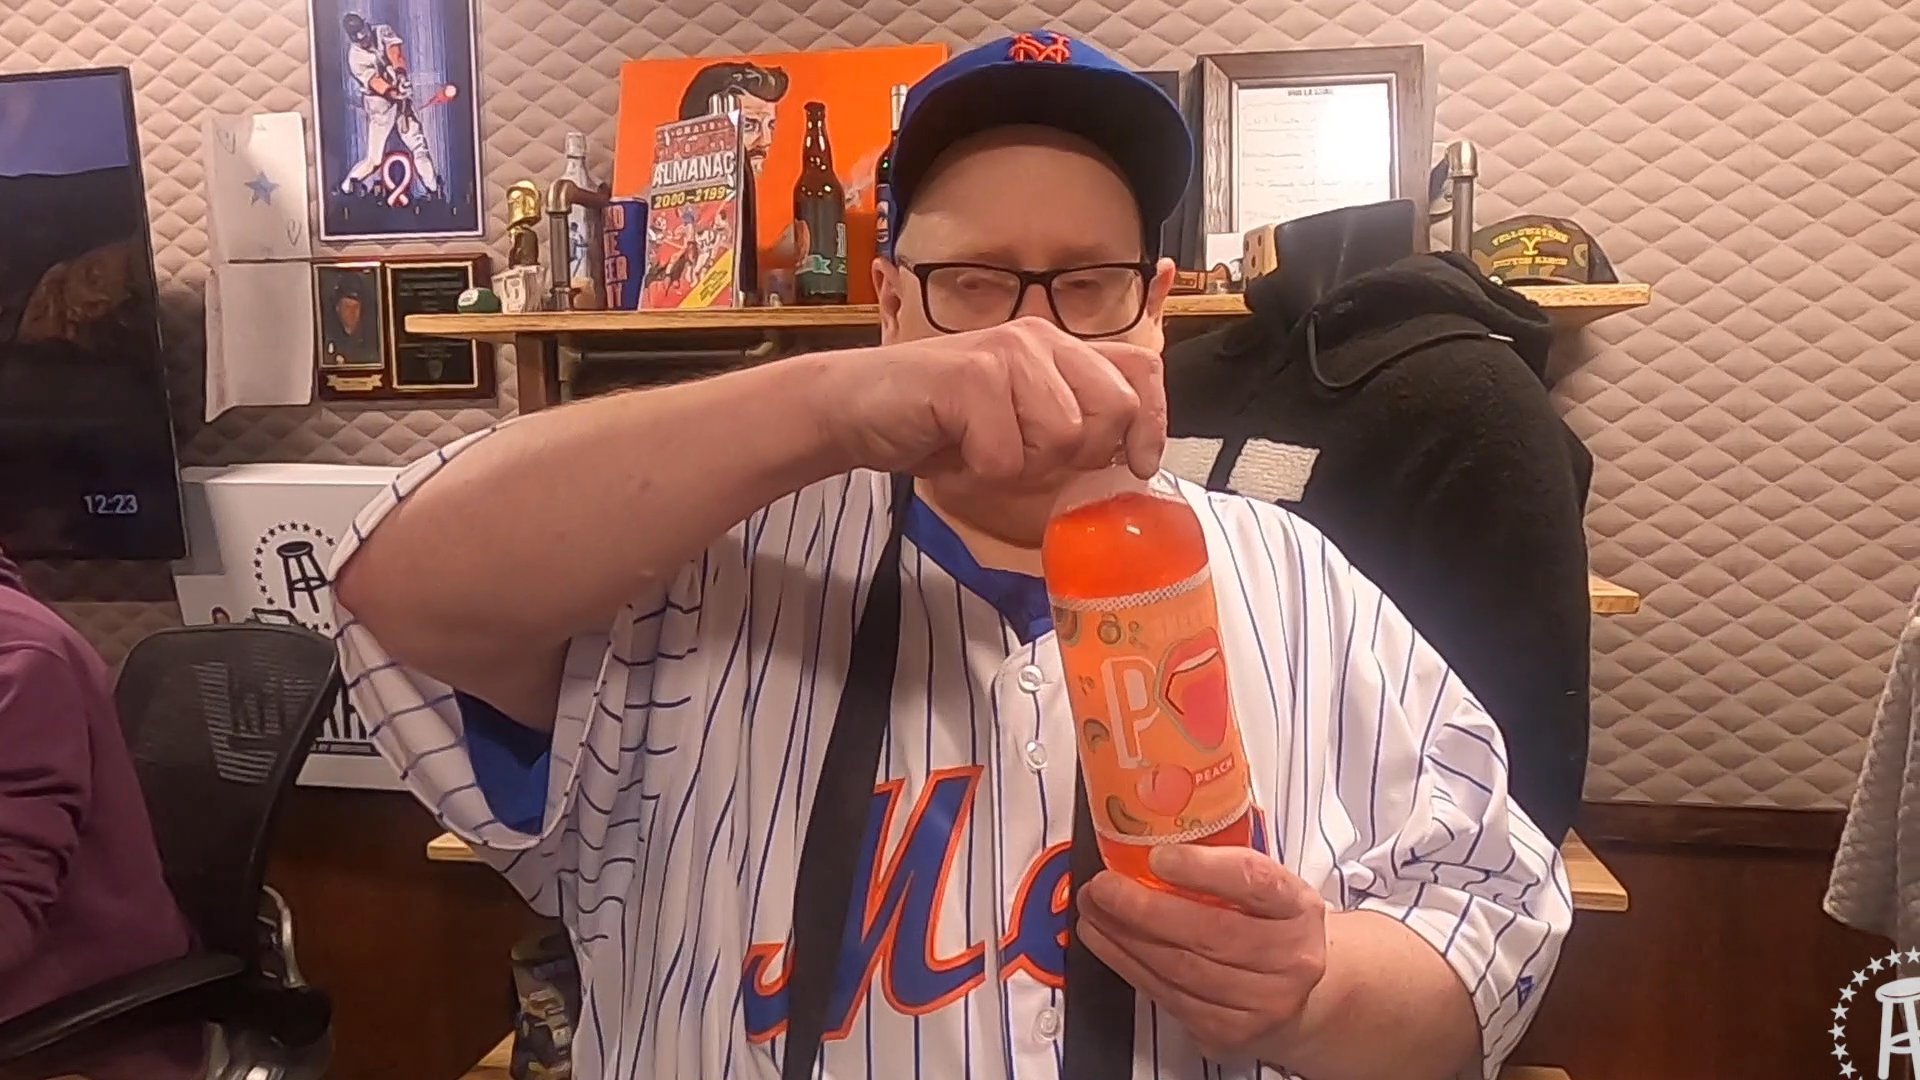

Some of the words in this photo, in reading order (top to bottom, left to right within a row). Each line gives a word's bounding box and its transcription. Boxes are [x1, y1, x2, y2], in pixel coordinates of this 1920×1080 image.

[652, 151, 736, 187] ALMANAC
[82, 494, 138, 514] 12:23
[1194, 756, 1234, 785] PEACH
[743, 765, 1270, 1043] Me
